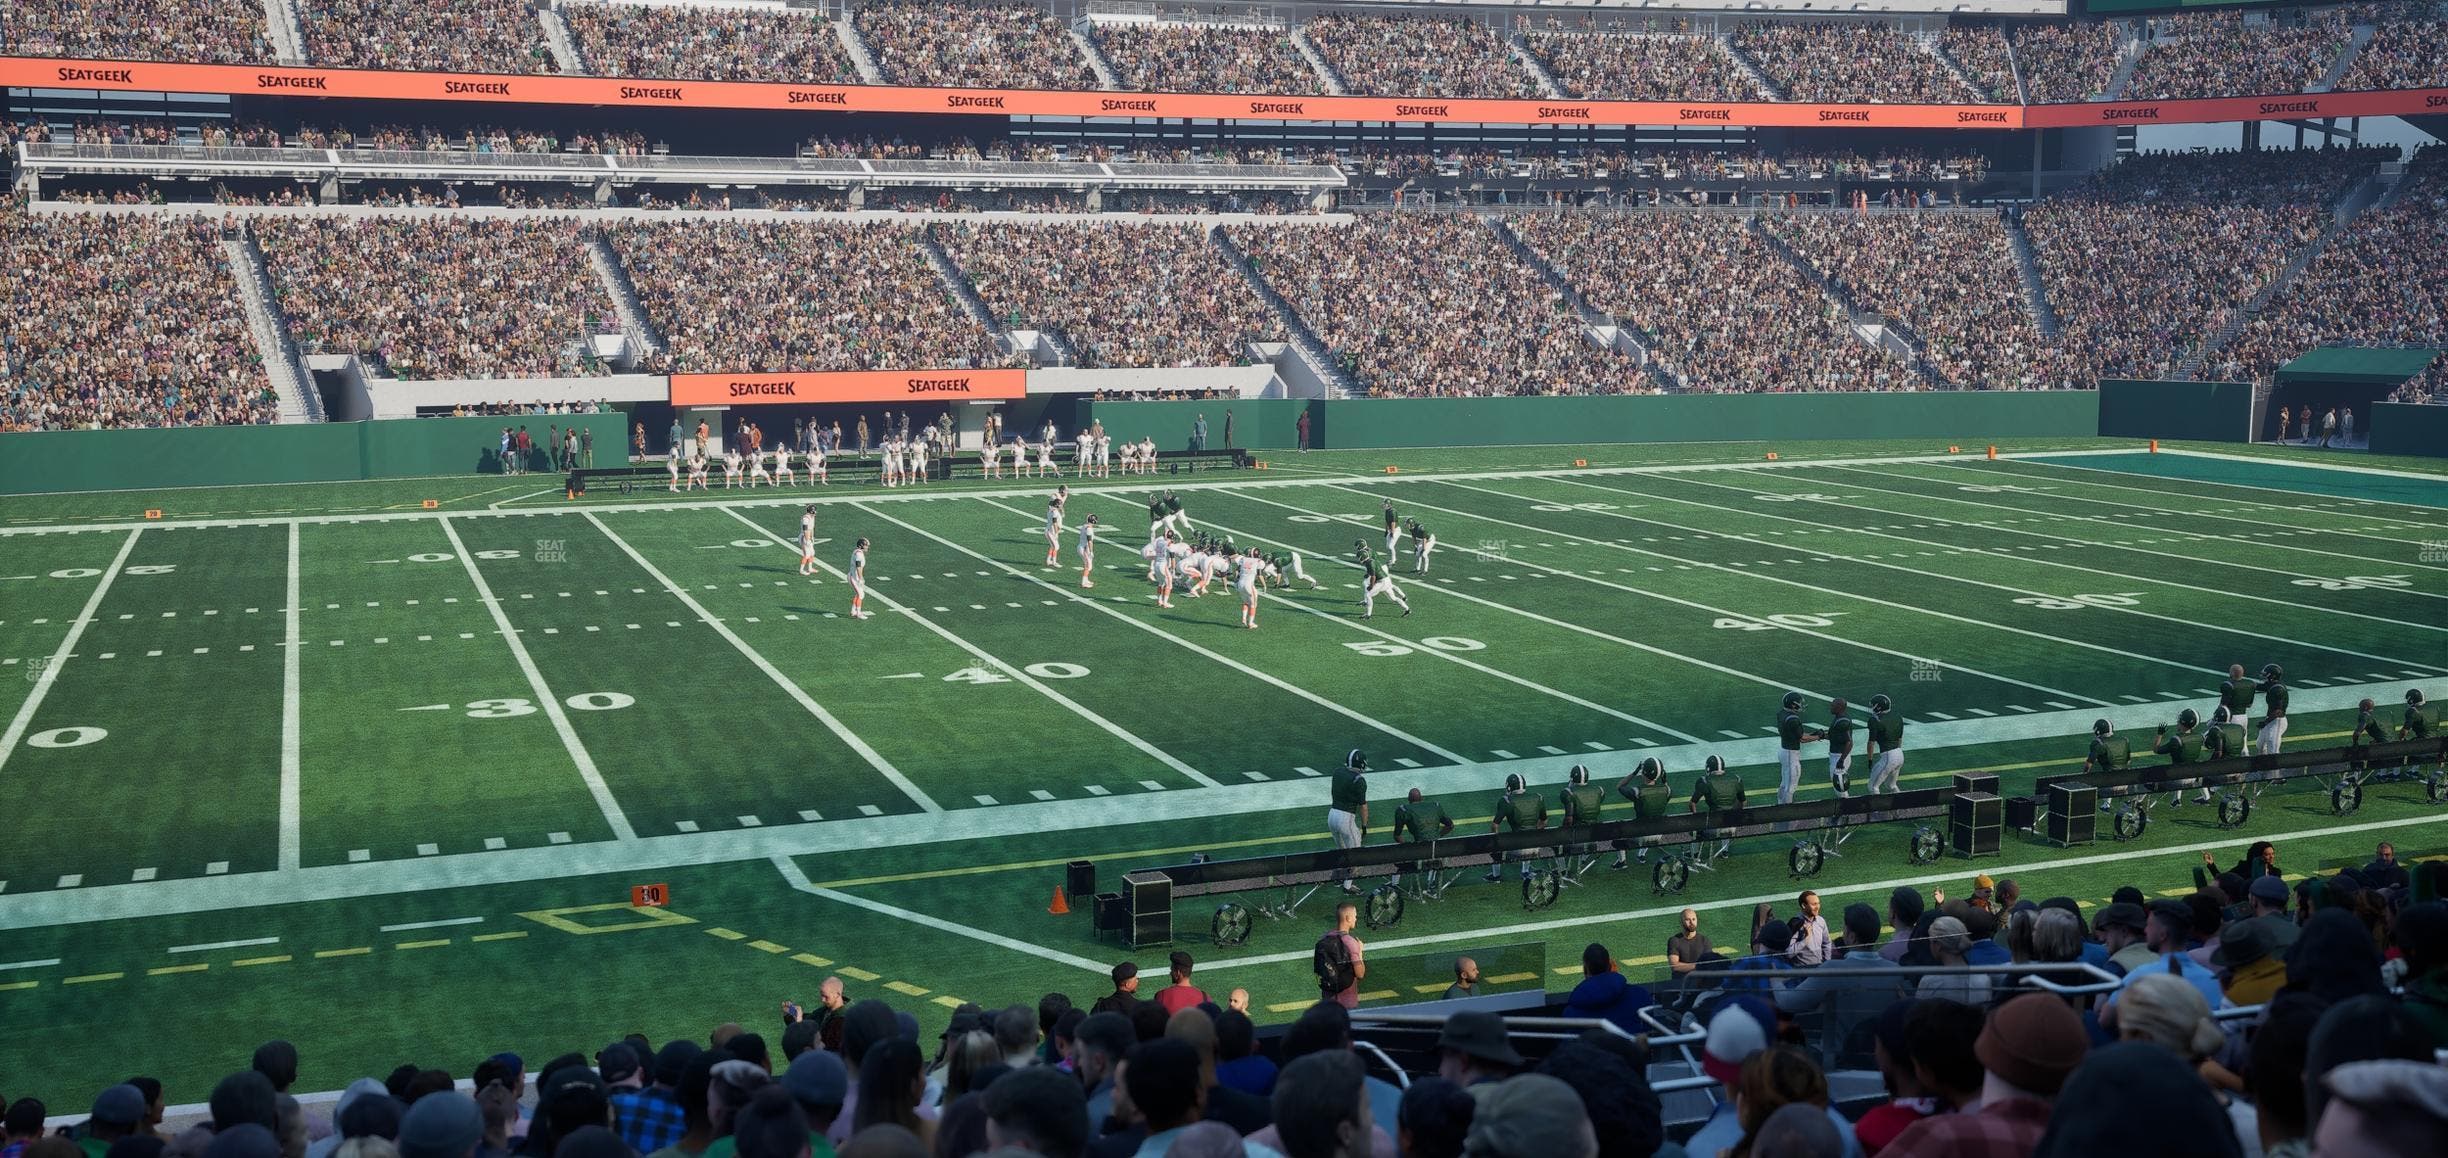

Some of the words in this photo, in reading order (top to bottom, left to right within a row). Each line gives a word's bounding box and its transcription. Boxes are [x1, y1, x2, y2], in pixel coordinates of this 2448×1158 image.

[58, 68, 133, 83] SEATGEEK
[258, 75, 327, 90] SEATGEEK
[445, 82, 510, 95] SEATGEEK
[620, 87, 682, 100] SEATGEEK
[788, 92, 847, 105] SEATGEEK
[947, 96, 1004, 109] SEATGEEK
[1102, 100, 1156, 112] SEATGEEK
[1251, 103, 1303, 114] SEATGEEK
[2259, 101, 2318, 114] SEATGEEK
[1396, 105, 1448, 117] SEATGEEK
[1538, 107, 1590, 119] SEATGEEK
[1680, 109, 1730, 120] SEATGEEK
[1819, 110, 1869, 121] SEATGEEK
[1958, 112, 2007, 123] SEATGEEK
[2102, 108, 2159, 120] SEATGEEK
[730, 382, 796, 396] SEATGEEK
[908, 379, 970, 393] SEATGEEK
